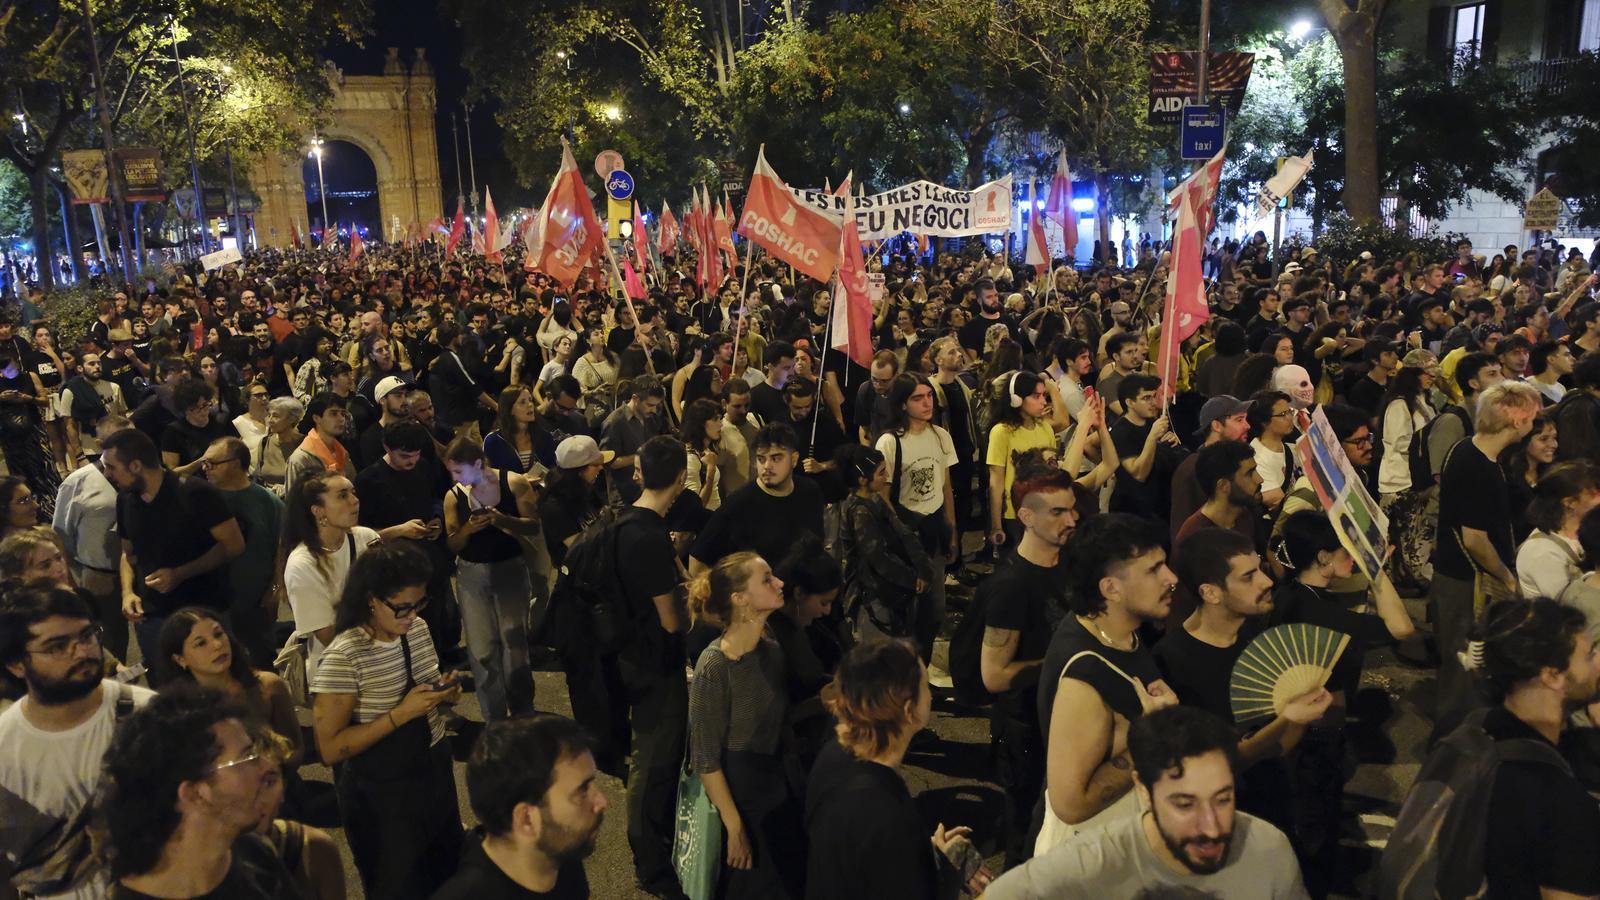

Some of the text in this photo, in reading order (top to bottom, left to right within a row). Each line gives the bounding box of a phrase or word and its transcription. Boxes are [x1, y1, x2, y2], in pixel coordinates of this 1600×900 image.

[1153, 97, 1192, 112] AIDA
[1195, 141, 1212, 150] taxi
[723, 183, 744, 191] AIDA
[855, 204, 969, 234] EU NEGOCI
[743, 210, 819, 266] COSHAC
